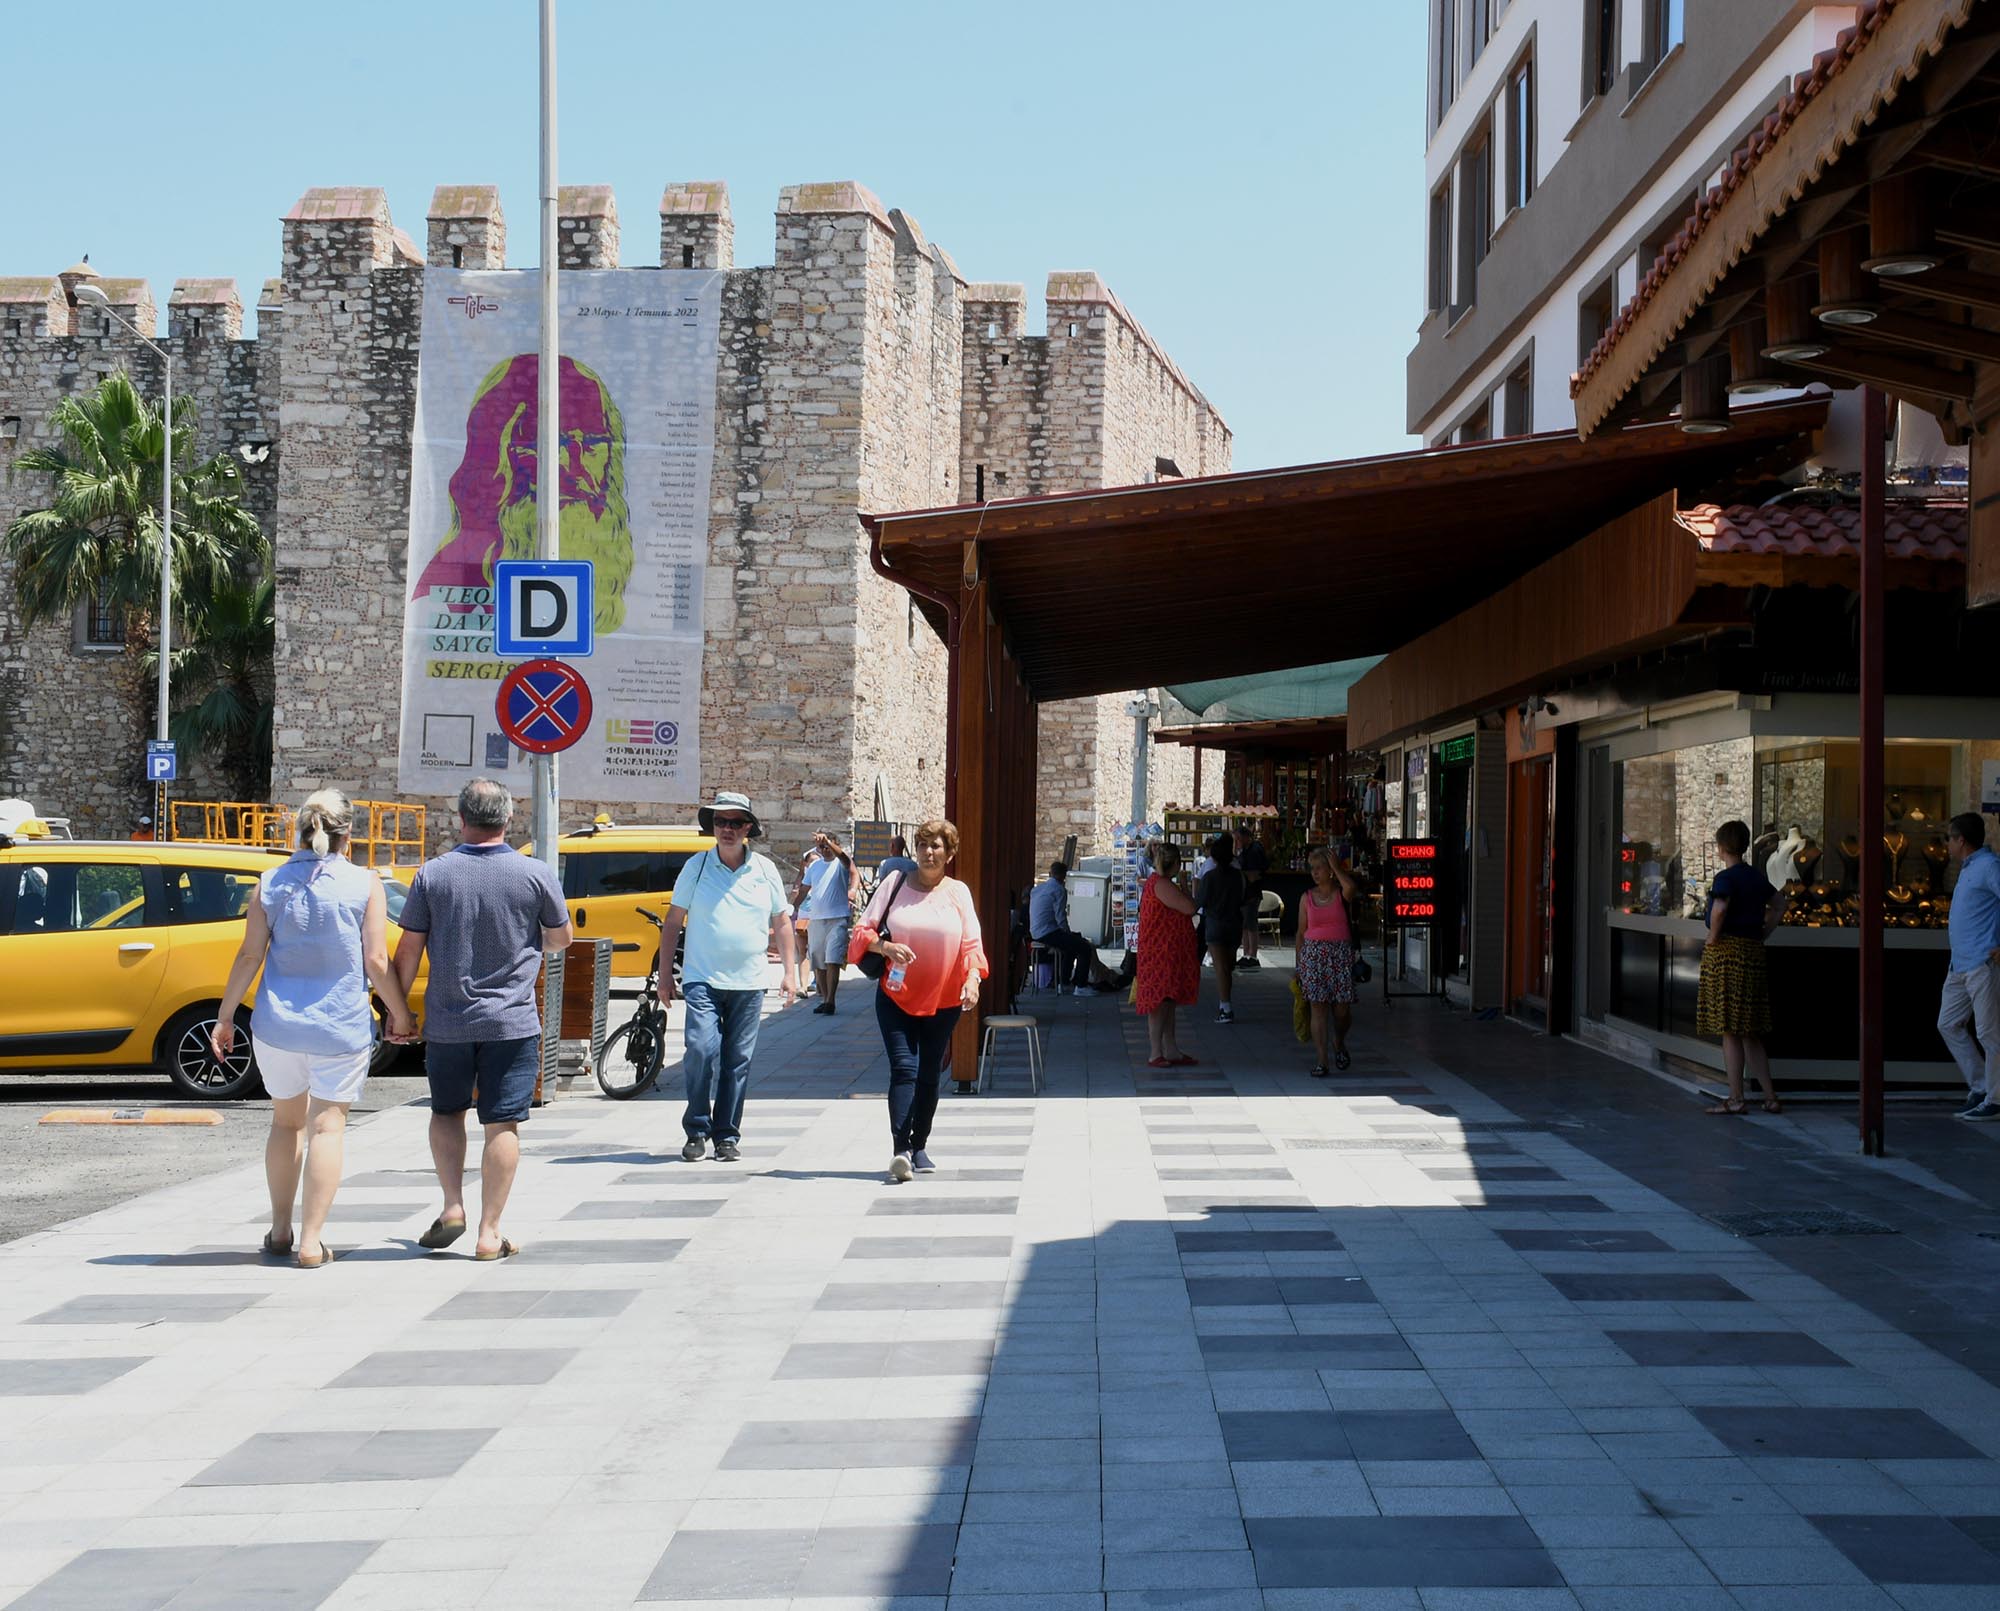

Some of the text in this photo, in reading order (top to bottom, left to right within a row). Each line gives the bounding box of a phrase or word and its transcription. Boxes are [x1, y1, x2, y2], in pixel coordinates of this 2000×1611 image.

[577, 307, 590, 317] 22
[634, 307, 672, 317] Temmuz
[674, 307, 699, 317] 2022
[520, 579, 568, 638] D
[434, 613, 466, 630] DA
[433, 635, 492, 653] SAYG
[154, 758, 170, 777] P
[420, 759, 455, 767] MODERN
[1394, 876, 1434, 889] 16.500
[1394, 903, 1434, 916] 17.200
